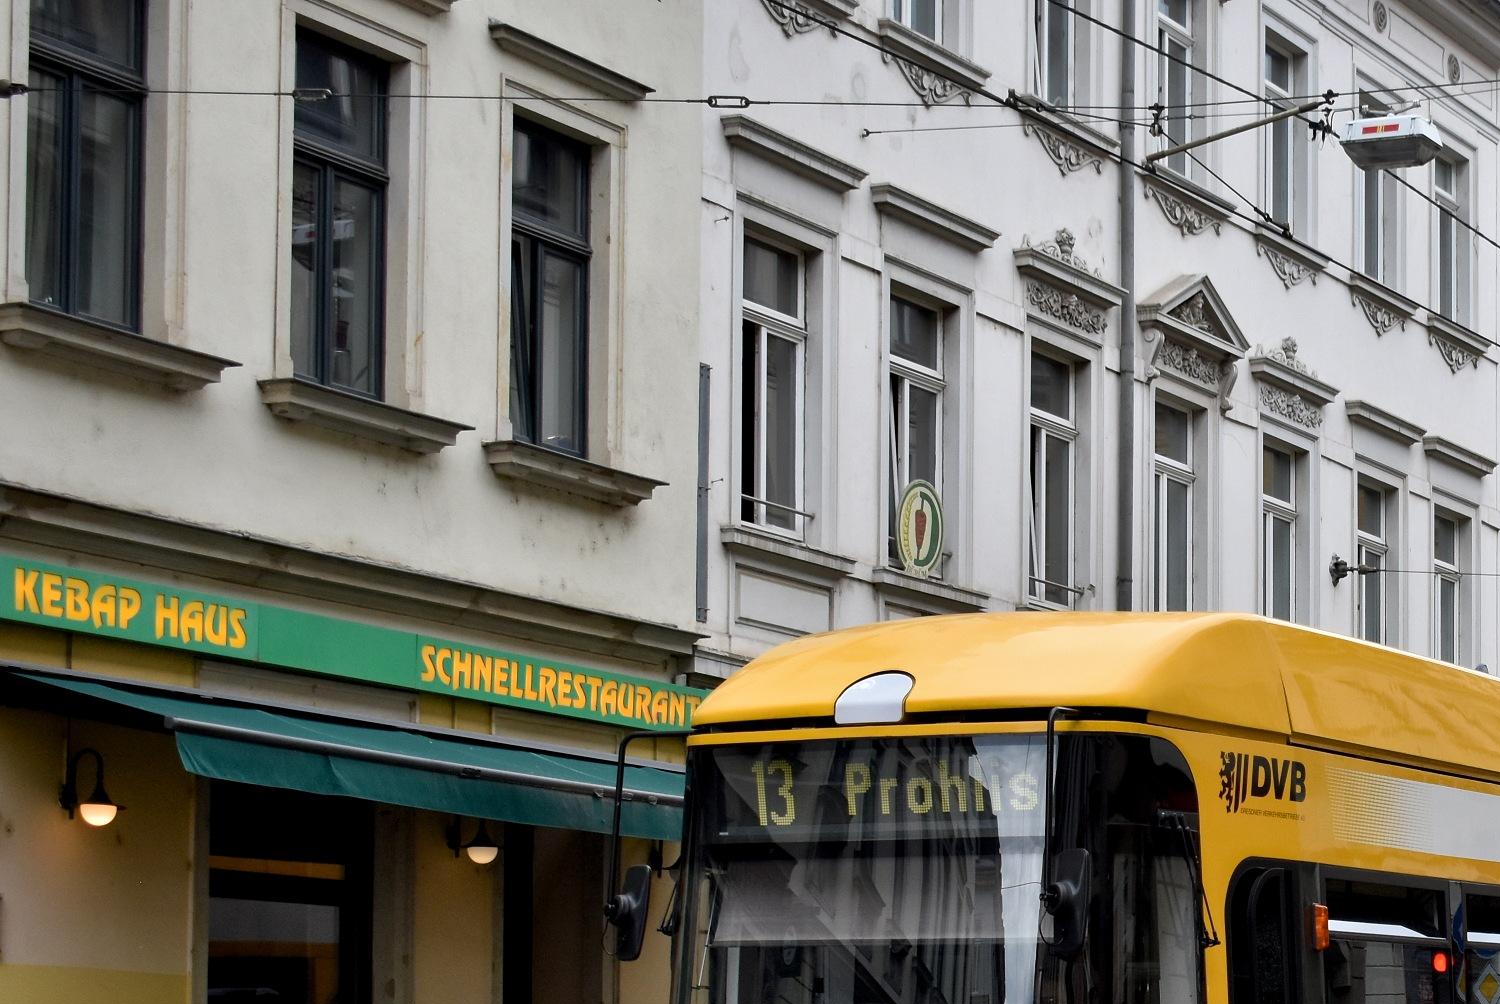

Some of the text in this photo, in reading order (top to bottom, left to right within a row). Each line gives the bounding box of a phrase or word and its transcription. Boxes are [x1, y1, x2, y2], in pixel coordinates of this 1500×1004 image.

[14, 567, 248, 649] KEBAP HAUS
[420, 644, 702, 727] SCHNELLRESTAURANT
[752, 759, 1039, 826] 13 Prohlis
[1250, 754, 1307, 803] DVB
